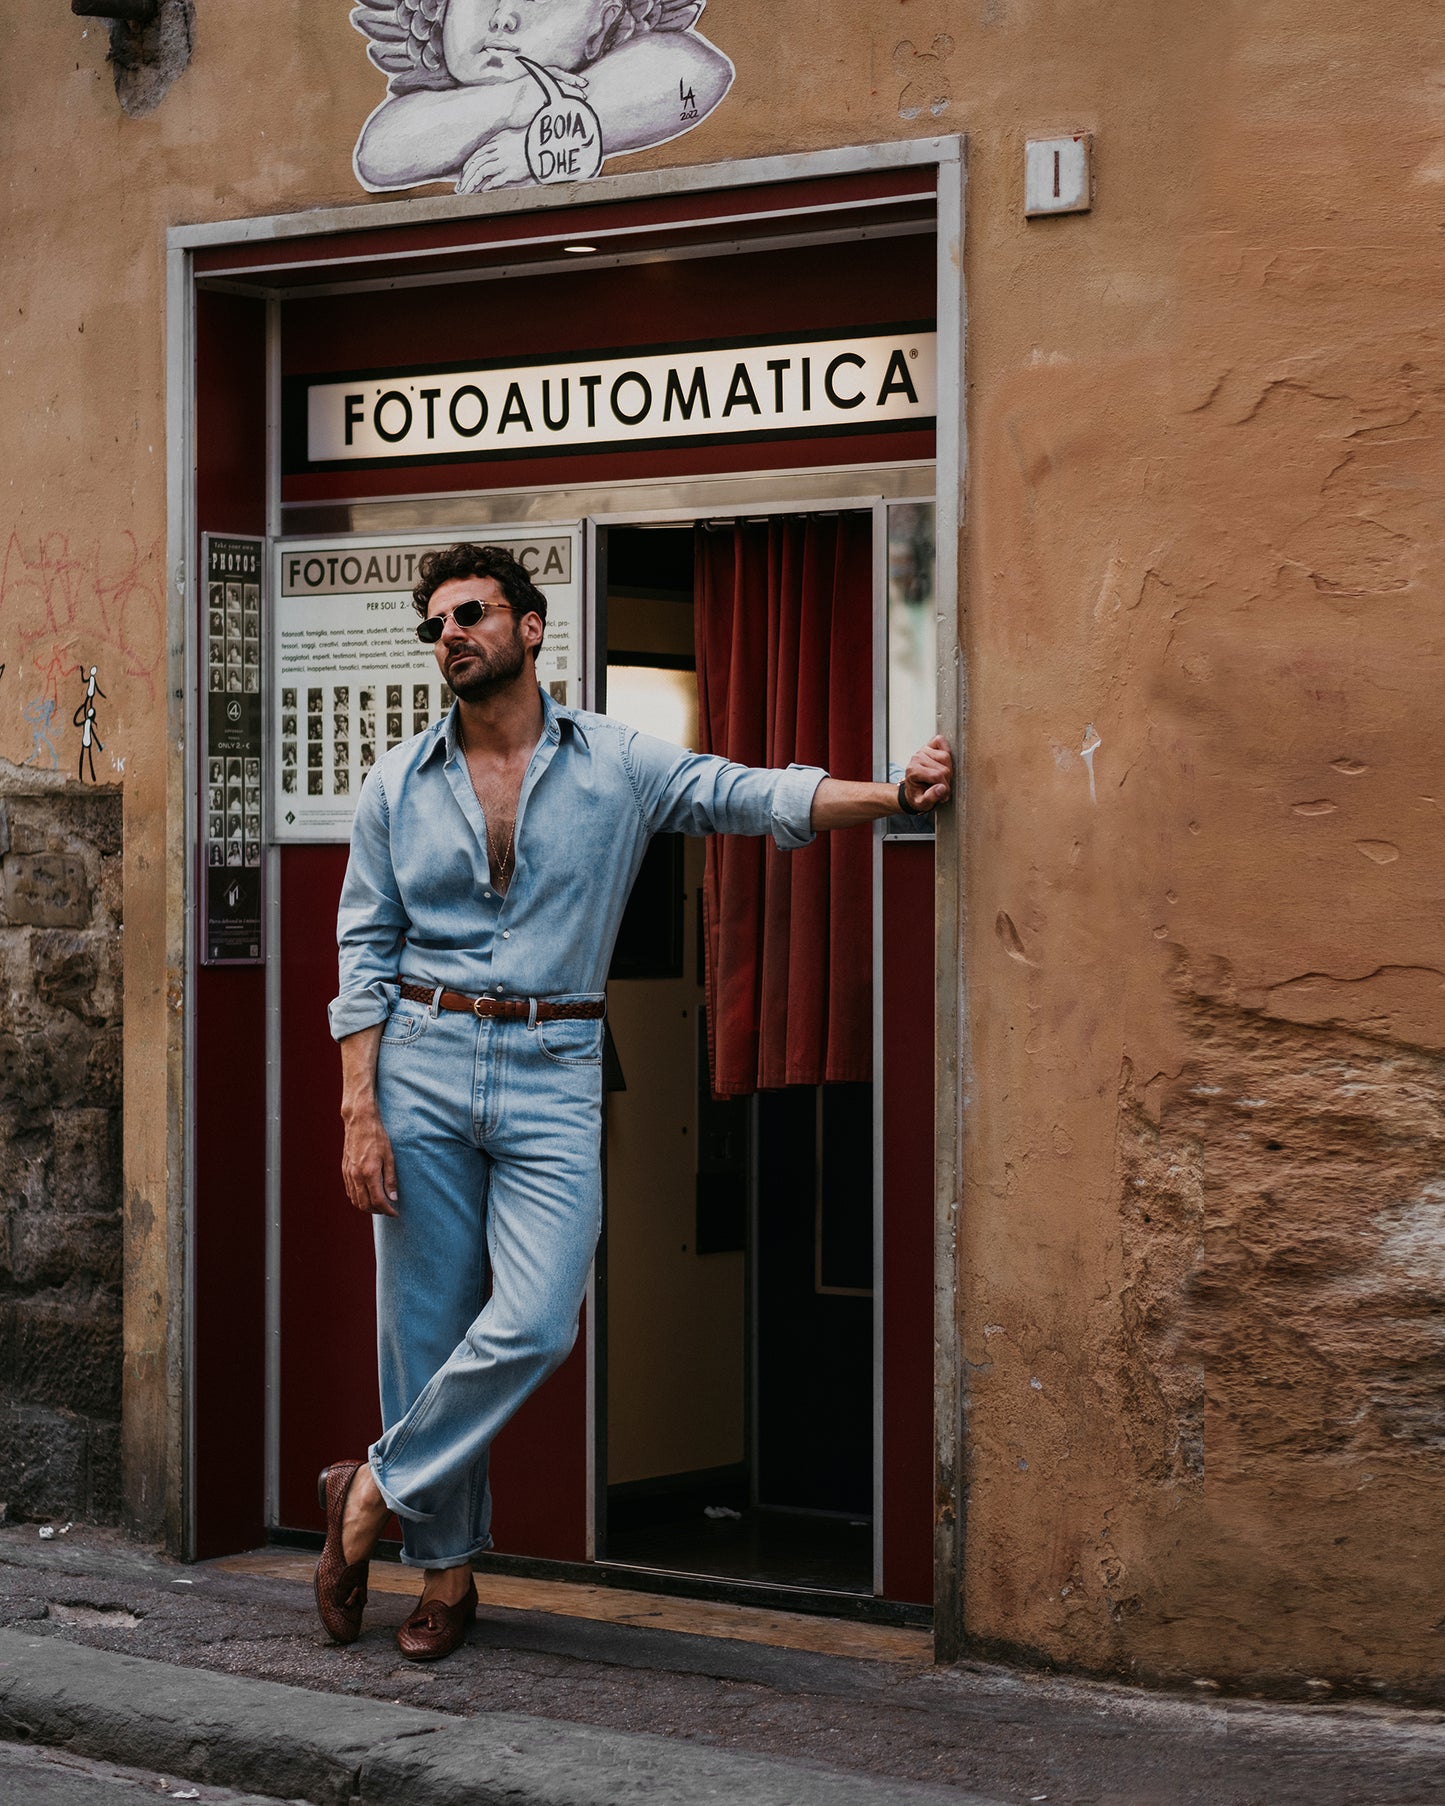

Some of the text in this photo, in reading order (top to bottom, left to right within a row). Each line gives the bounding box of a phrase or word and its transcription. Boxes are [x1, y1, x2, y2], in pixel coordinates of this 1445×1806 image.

[679, 109, 699, 121] 2022
[212, 552, 256, 573] PHOTOS
[366, 602, 379, 611] PER
[380, 601, 397, 610] SOLI
[229, 703, 239, 718] 4
